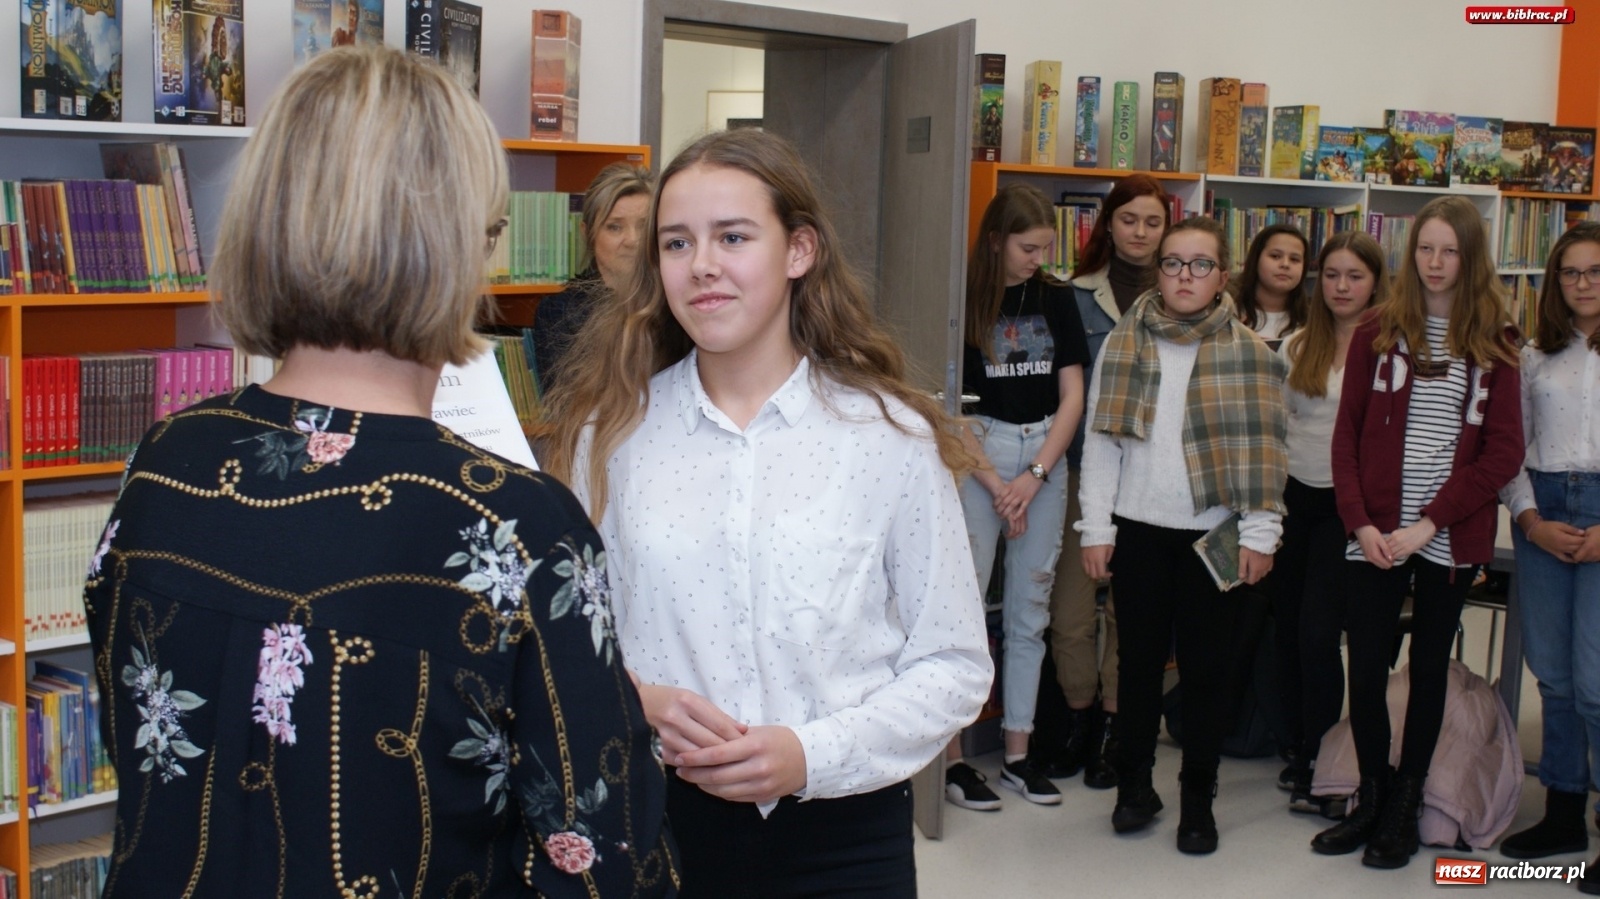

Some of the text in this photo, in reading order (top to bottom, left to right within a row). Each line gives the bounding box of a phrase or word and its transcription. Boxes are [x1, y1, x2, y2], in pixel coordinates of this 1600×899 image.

[444, 7, 480, 26] CIVILIZATION
[31, 0, 45, 76] DOMINION
[420, 13, 431, 59] CIVIL
[1412, 121, 1440, 136] RIVER
[433, 406, 476, 419] awiec
